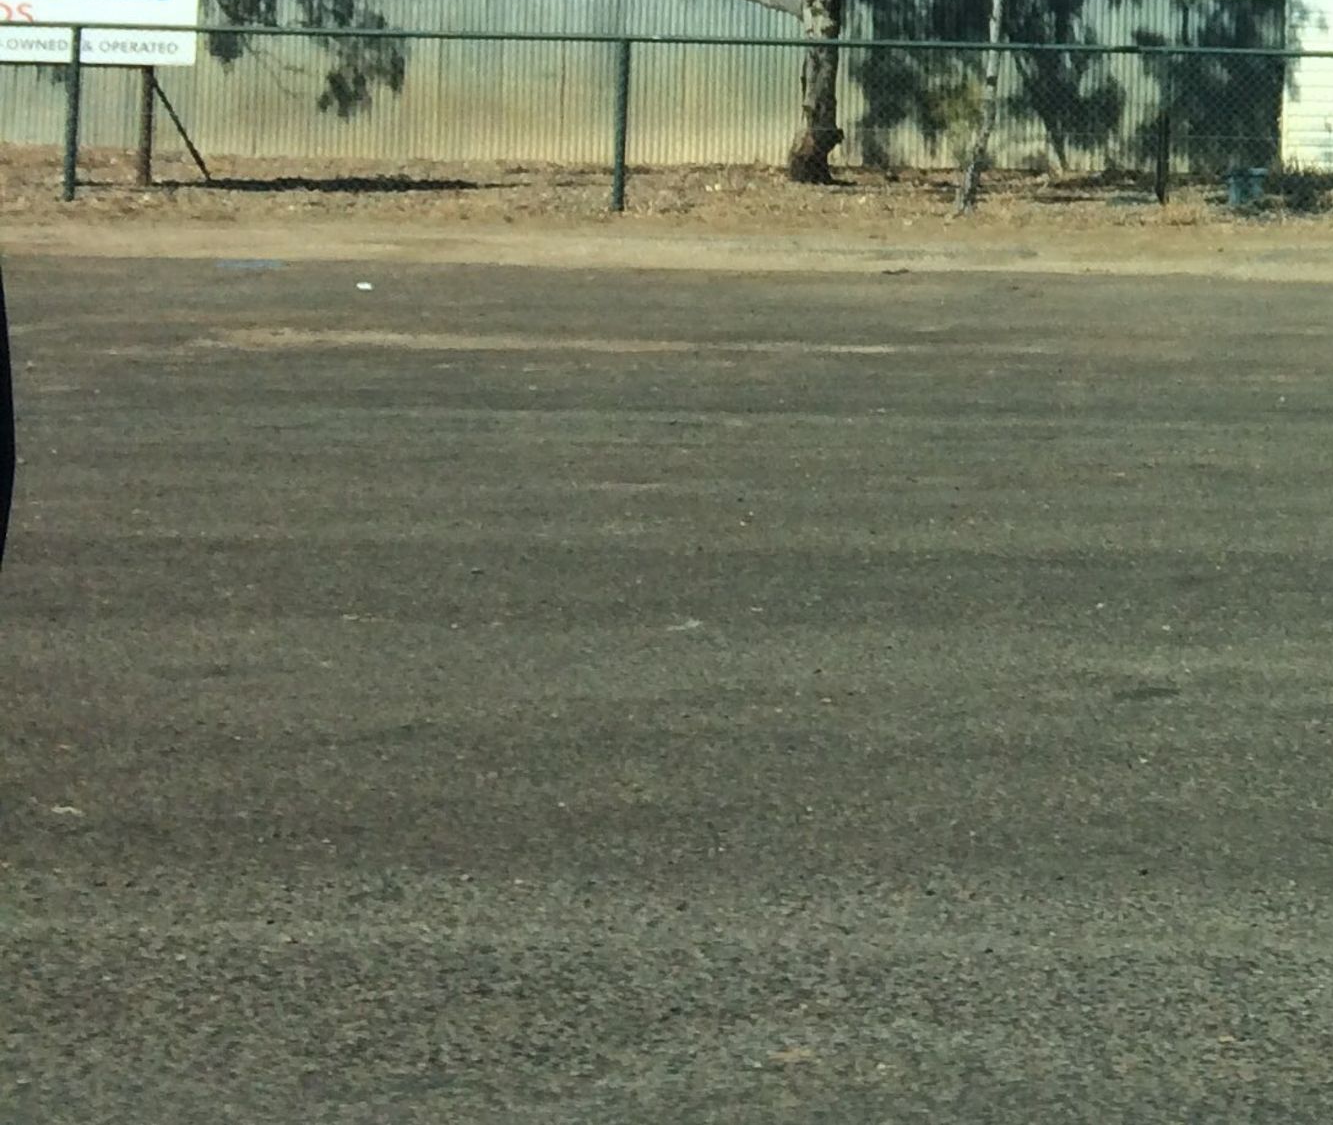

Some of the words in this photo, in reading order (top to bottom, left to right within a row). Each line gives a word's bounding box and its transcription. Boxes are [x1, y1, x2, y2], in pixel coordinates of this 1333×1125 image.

[6, 38, 68, 53] OWNED
[82, 41, 94, 53] &
[98, 41, 179, 55] OPERATED
